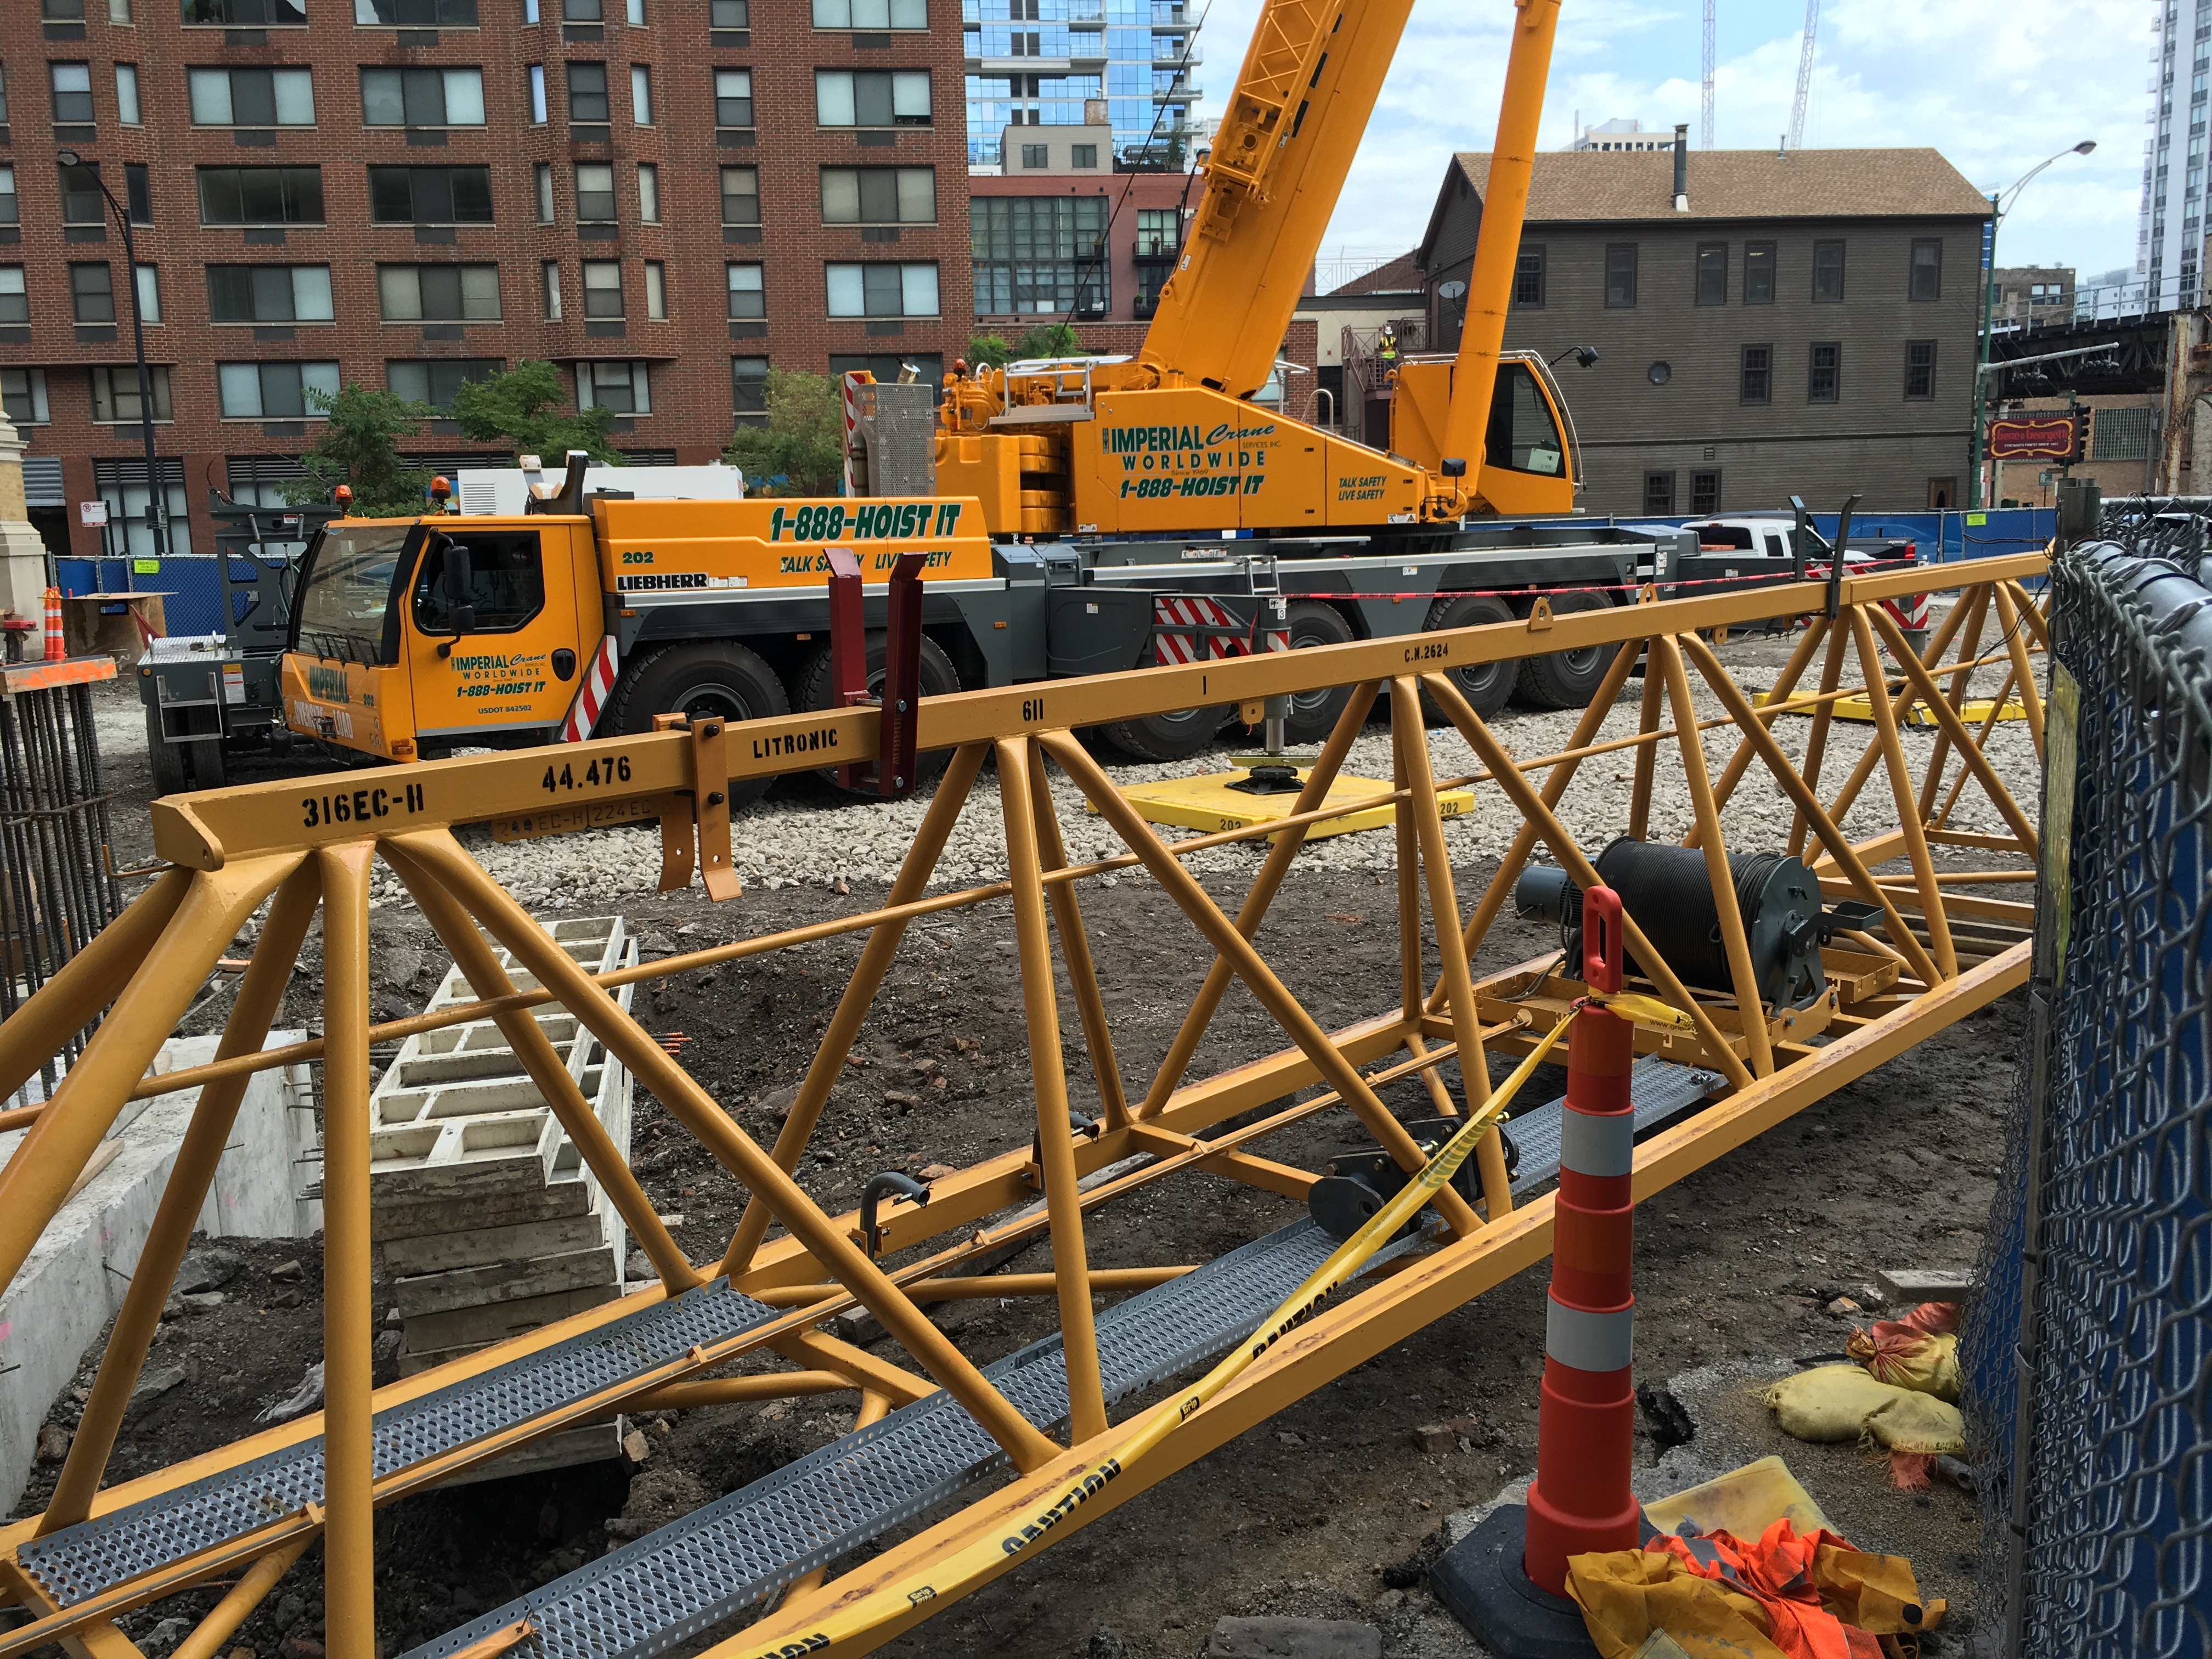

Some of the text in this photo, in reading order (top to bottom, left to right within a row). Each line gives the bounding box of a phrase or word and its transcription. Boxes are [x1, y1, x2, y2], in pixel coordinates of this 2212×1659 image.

[1111, 426, 1204, 453] IMPERIAL
[1206, 424, 1274, 445] Crane
[1122, 451, 1265, 470] WORLDWIDE
[1120, 475, 1264, 499] 1-888-HOIST IT
[1339, 476, 1387, 488] TALK SAFETY
[1338, 489, 1385, 501] LIVE SAFETY
[770, 503, 962, 542] 1-888-HOIST IT
[623, 551, 654, 564] 202
[781, 556, 812, 573] TALK
[618, 574, 707, 590] LIEBHERR
[1279, 610, 1284, 618] 3
[1404, 642, 1448, 663] C.N.2624
[456, 654, 546, 671] IMPERIAL Crane
[463, 668, 540, 680] WORLDWIDE
[309, 665, 349, 704] IMPERIAL
[456, 681, 546, 698] 1-888-HOIST IT
[364, 693, 374, 707] 202
[333, 709, 354, 740] LOAD
[303, 727, 839, 828] 316EC-H 44.476 LITRONIC
[1440, 802, 1460, 814] 202
[1220, 819, 1242, 831] 202
[1182, 1399, 1197, 1415] Grip
[910, 1588, 931, 1600] Grip
